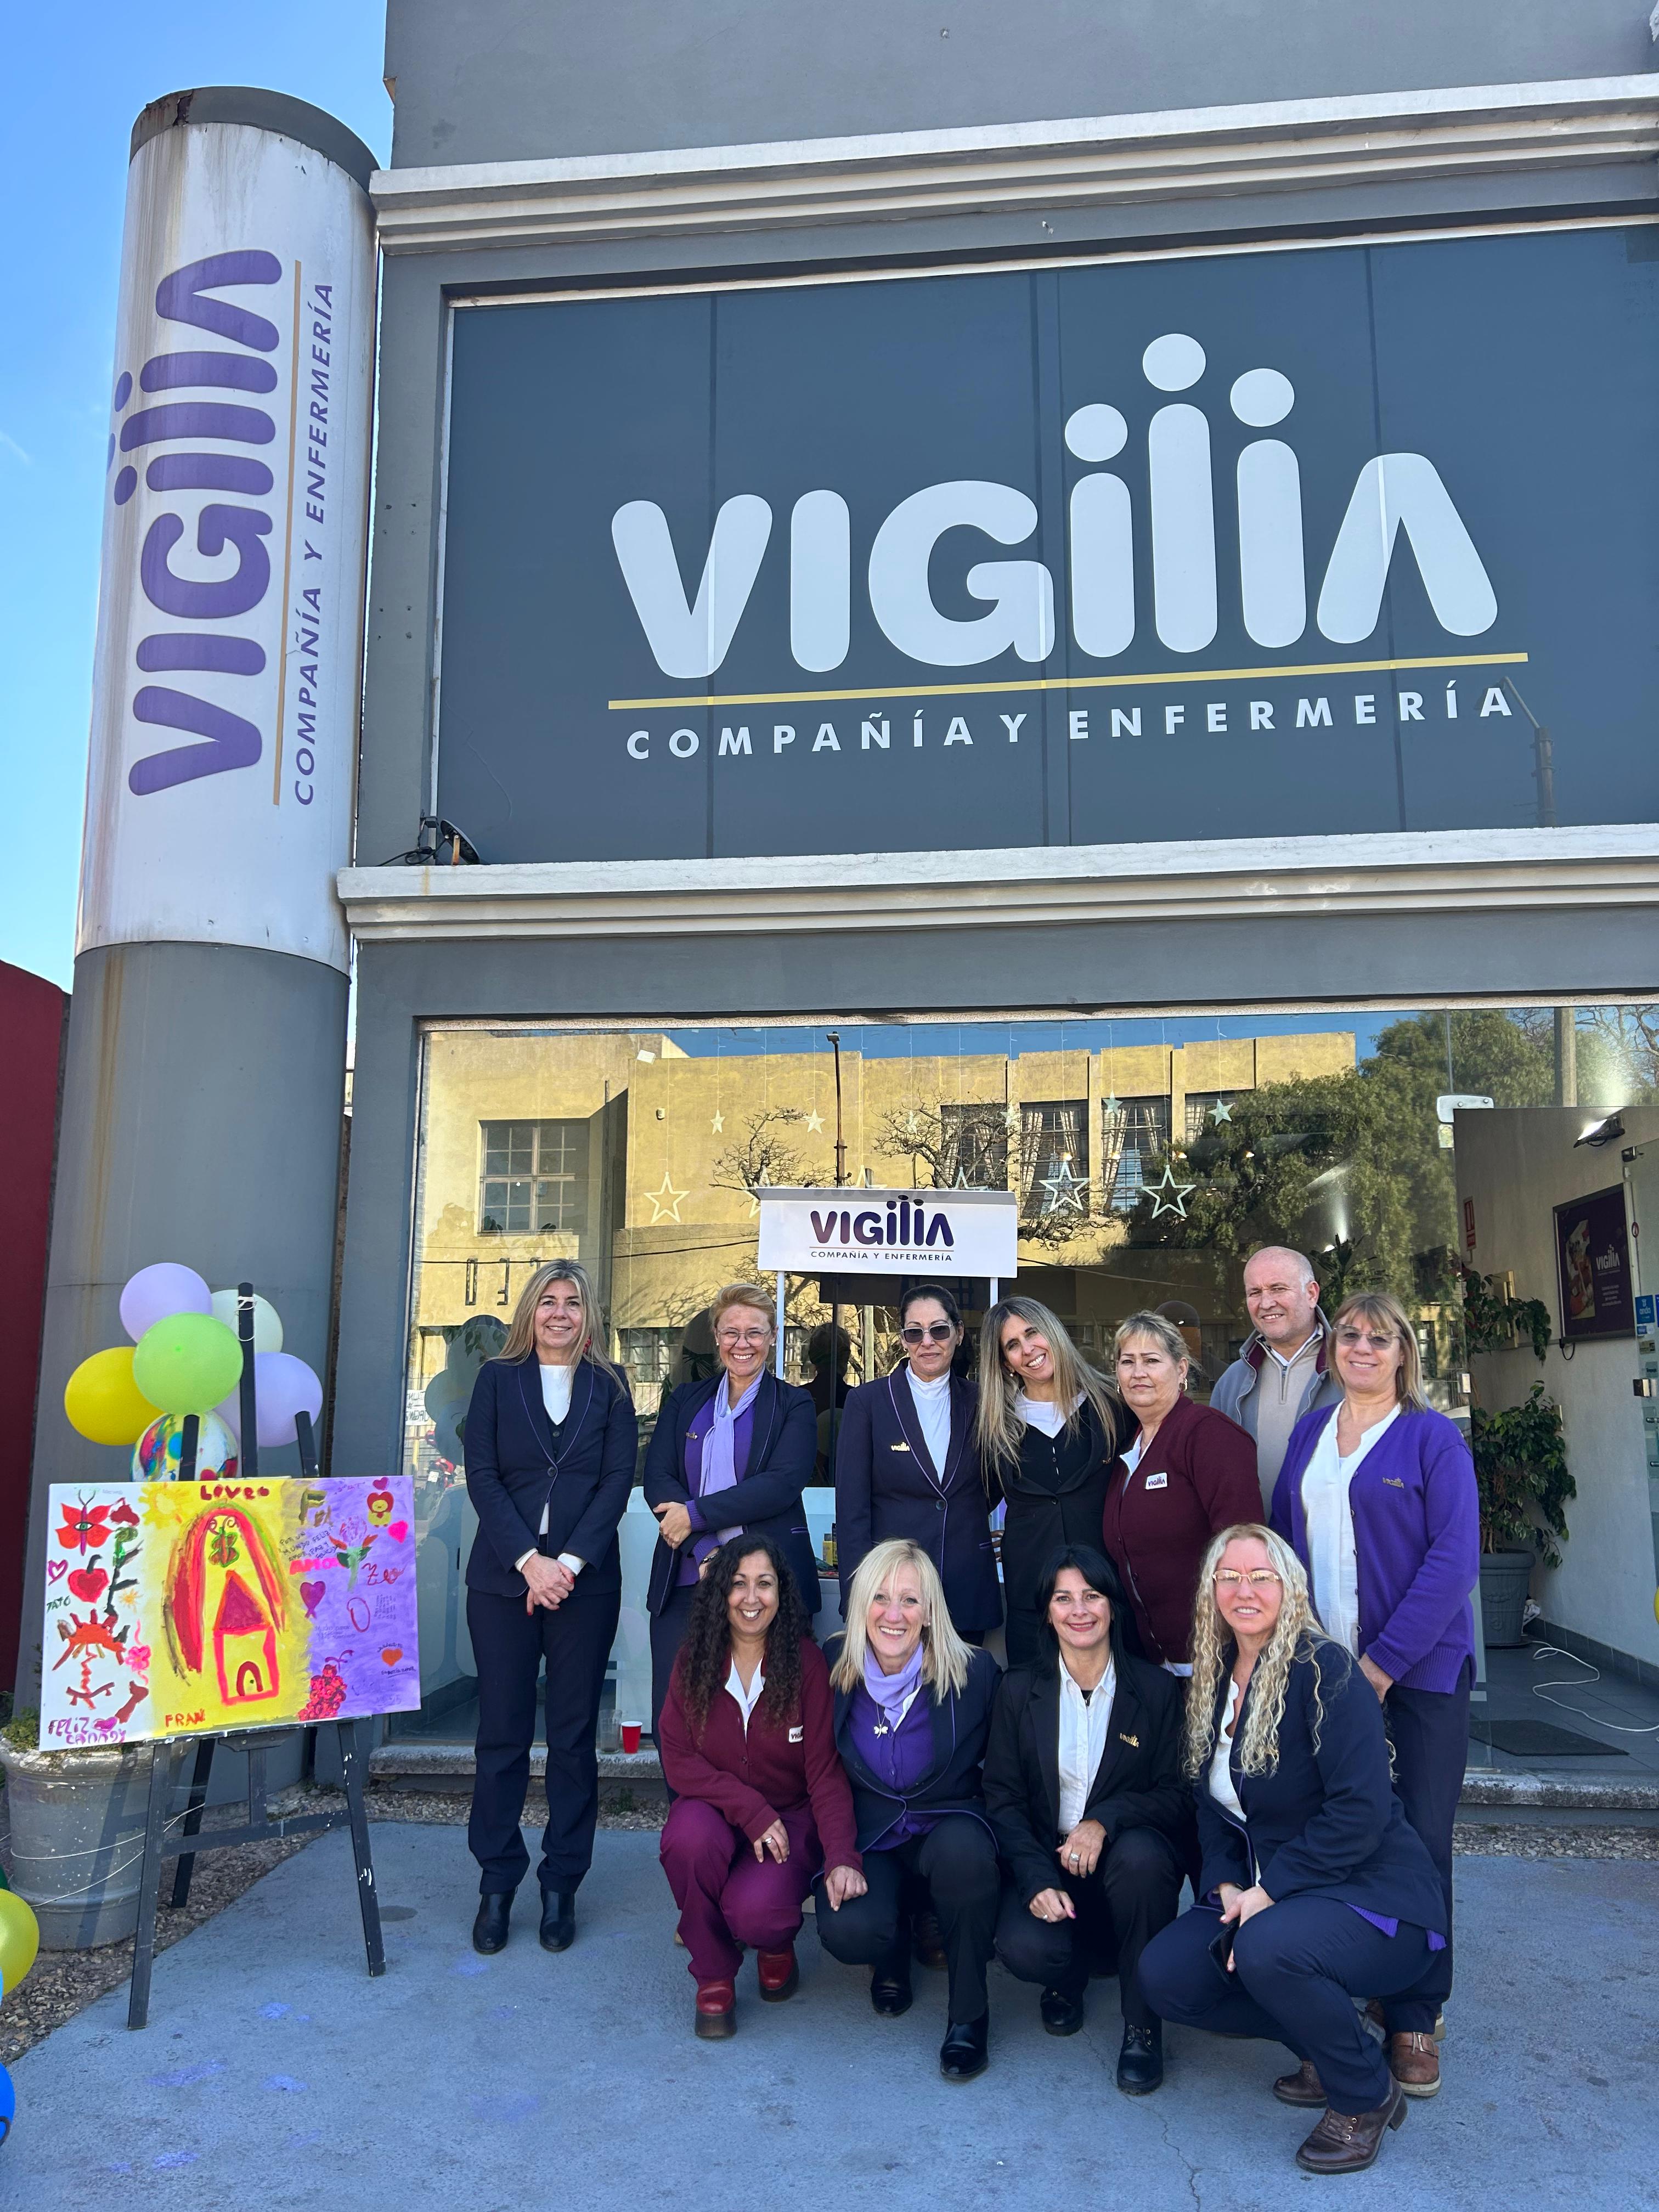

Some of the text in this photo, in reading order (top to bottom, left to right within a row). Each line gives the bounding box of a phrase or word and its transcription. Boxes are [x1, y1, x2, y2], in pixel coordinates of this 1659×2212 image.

[295, 285, 332, 805] COMPAÑÍA Y ENFERMERÍA
[627, 680, 1513, 760] COMPAÑÍA Y ENFERMERÍA
[811, 1250, 868, 1260] COMPAÑÍA
[885, 1253, 952, 1261] ENFERMERÍA
